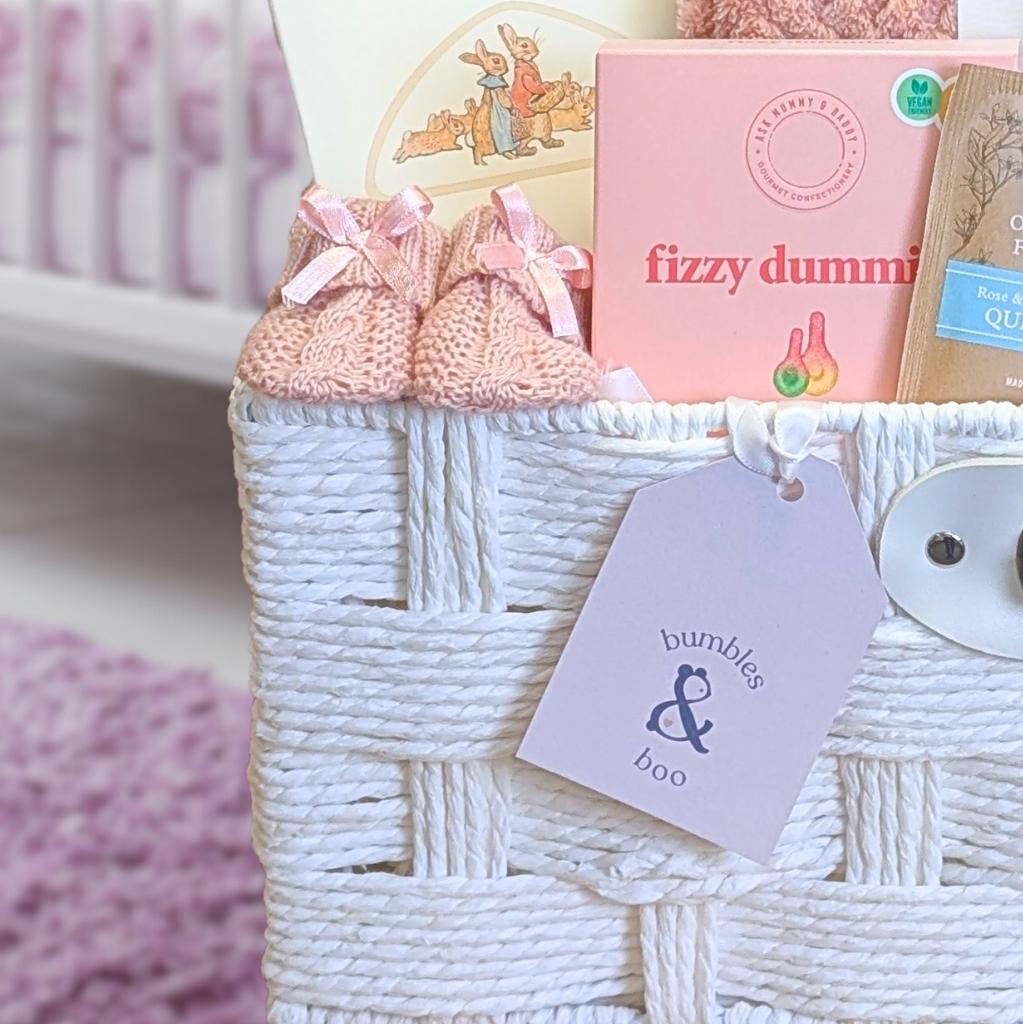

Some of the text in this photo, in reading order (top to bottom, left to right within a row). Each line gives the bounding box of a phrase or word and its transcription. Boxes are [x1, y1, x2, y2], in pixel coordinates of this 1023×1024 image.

[754, 119, 772, 143] ASK
[831, 107, 858, 142] DADDY
[757, 161, 855, 202] GOURMET CONFECTIONERY
[645, 243, 752, 296] fizzy
[977, 286, 1008, 302] Rose
[1012, 292, 1023, 305] &
[660, 628, 764, 691] bumbles
[646, 663, 714, 754] &
[633, 747, 687, 787] boo
